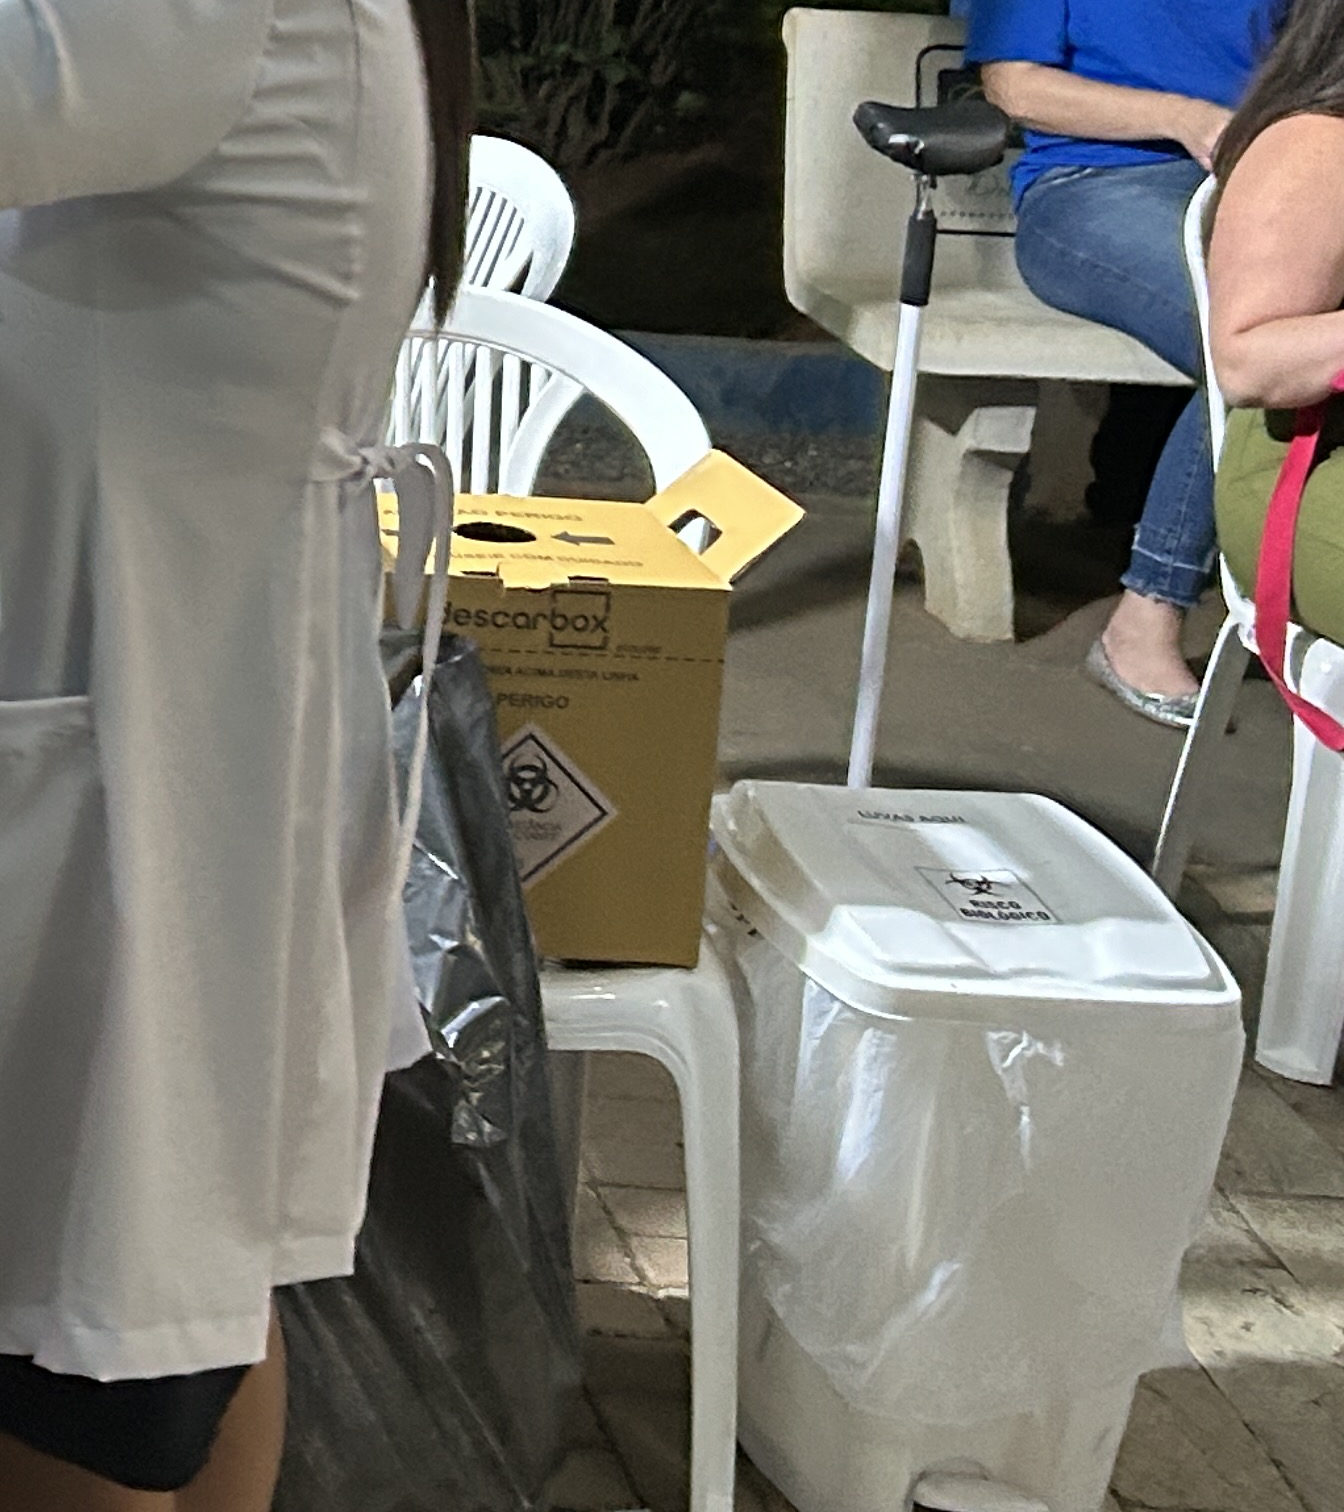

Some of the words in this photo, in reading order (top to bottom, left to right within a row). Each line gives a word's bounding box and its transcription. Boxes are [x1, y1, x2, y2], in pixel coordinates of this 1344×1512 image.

[496, 693, 570, 709] PERIGO
[969, 899, 1022, 910] RISCO
[960, 908, 1051, 921] BIOLÓGICO
